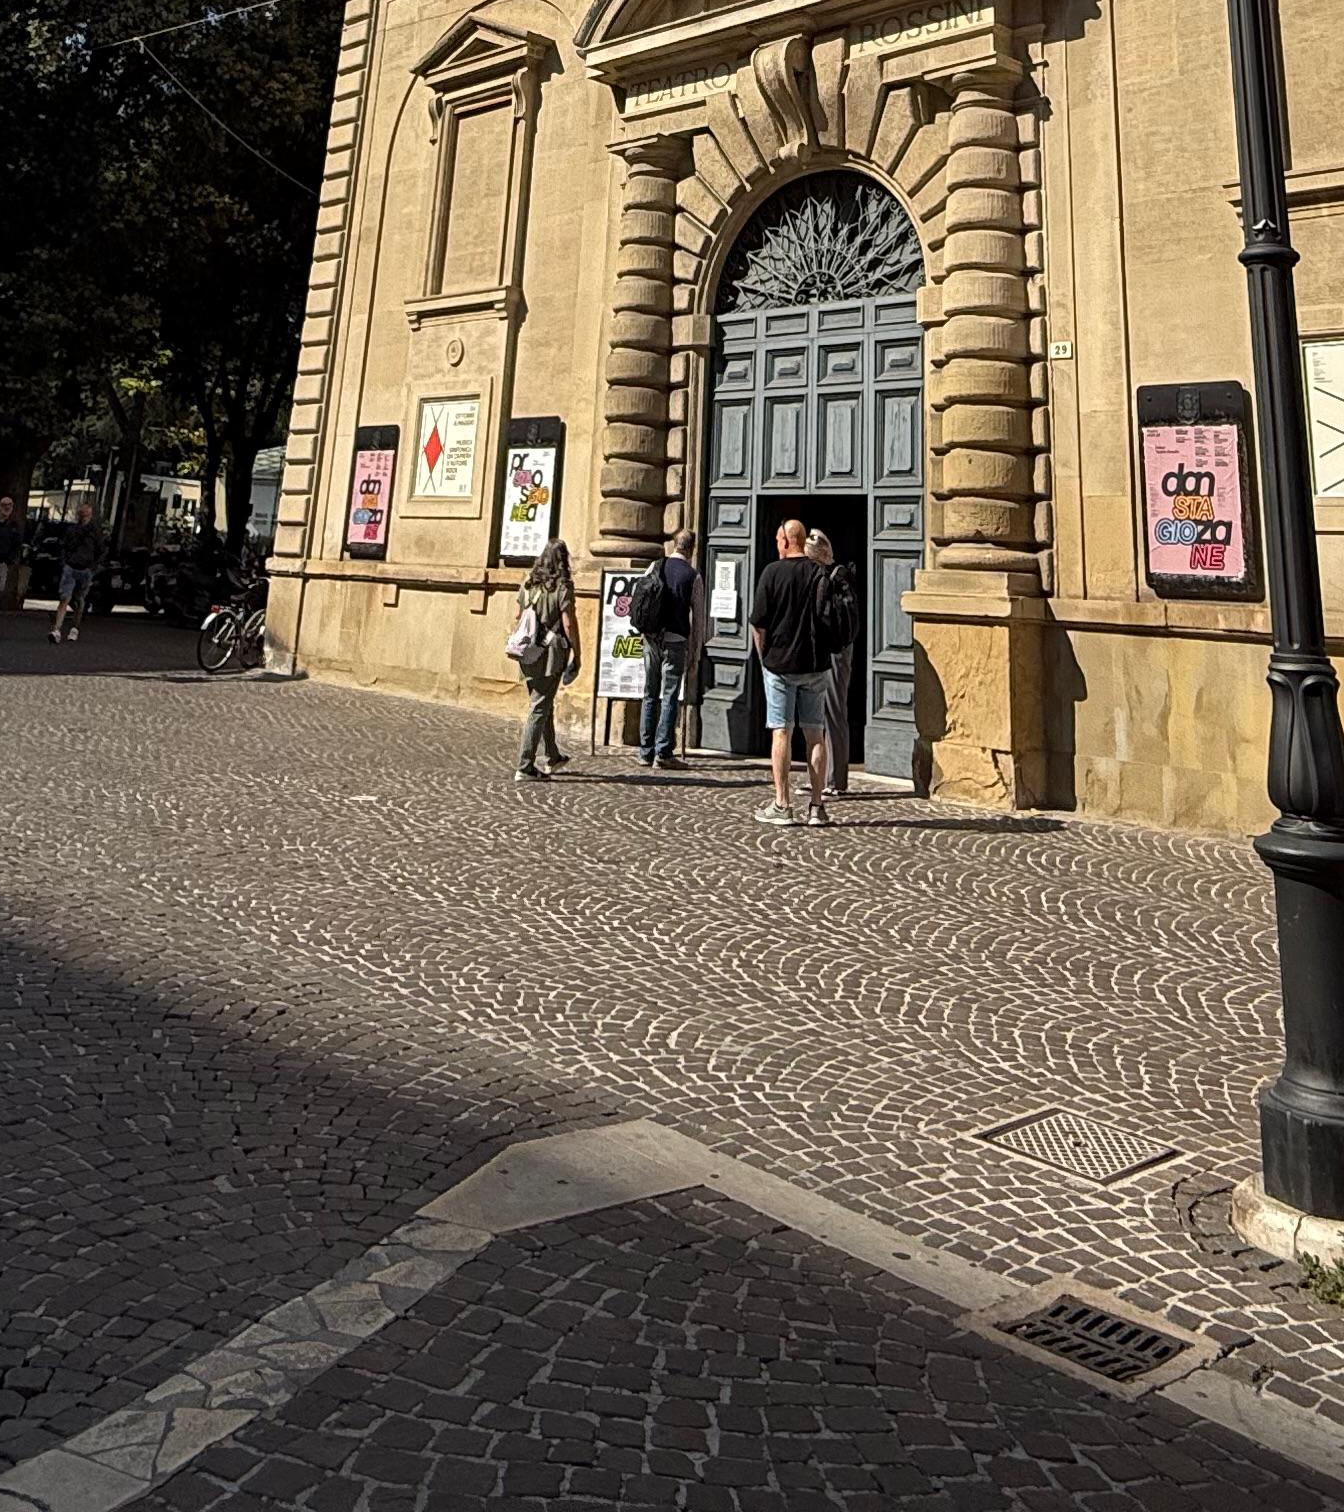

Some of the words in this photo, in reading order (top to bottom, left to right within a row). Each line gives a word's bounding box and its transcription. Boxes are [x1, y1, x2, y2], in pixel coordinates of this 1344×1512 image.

[631, 62, 731, 106] TEATRO
[1055, 344, 1067, 355] 29
[1172, 494, 1214, 521] STA
[1154, 518, 1197, 546] GIO
[1190, 543, 1226, 570] NE
